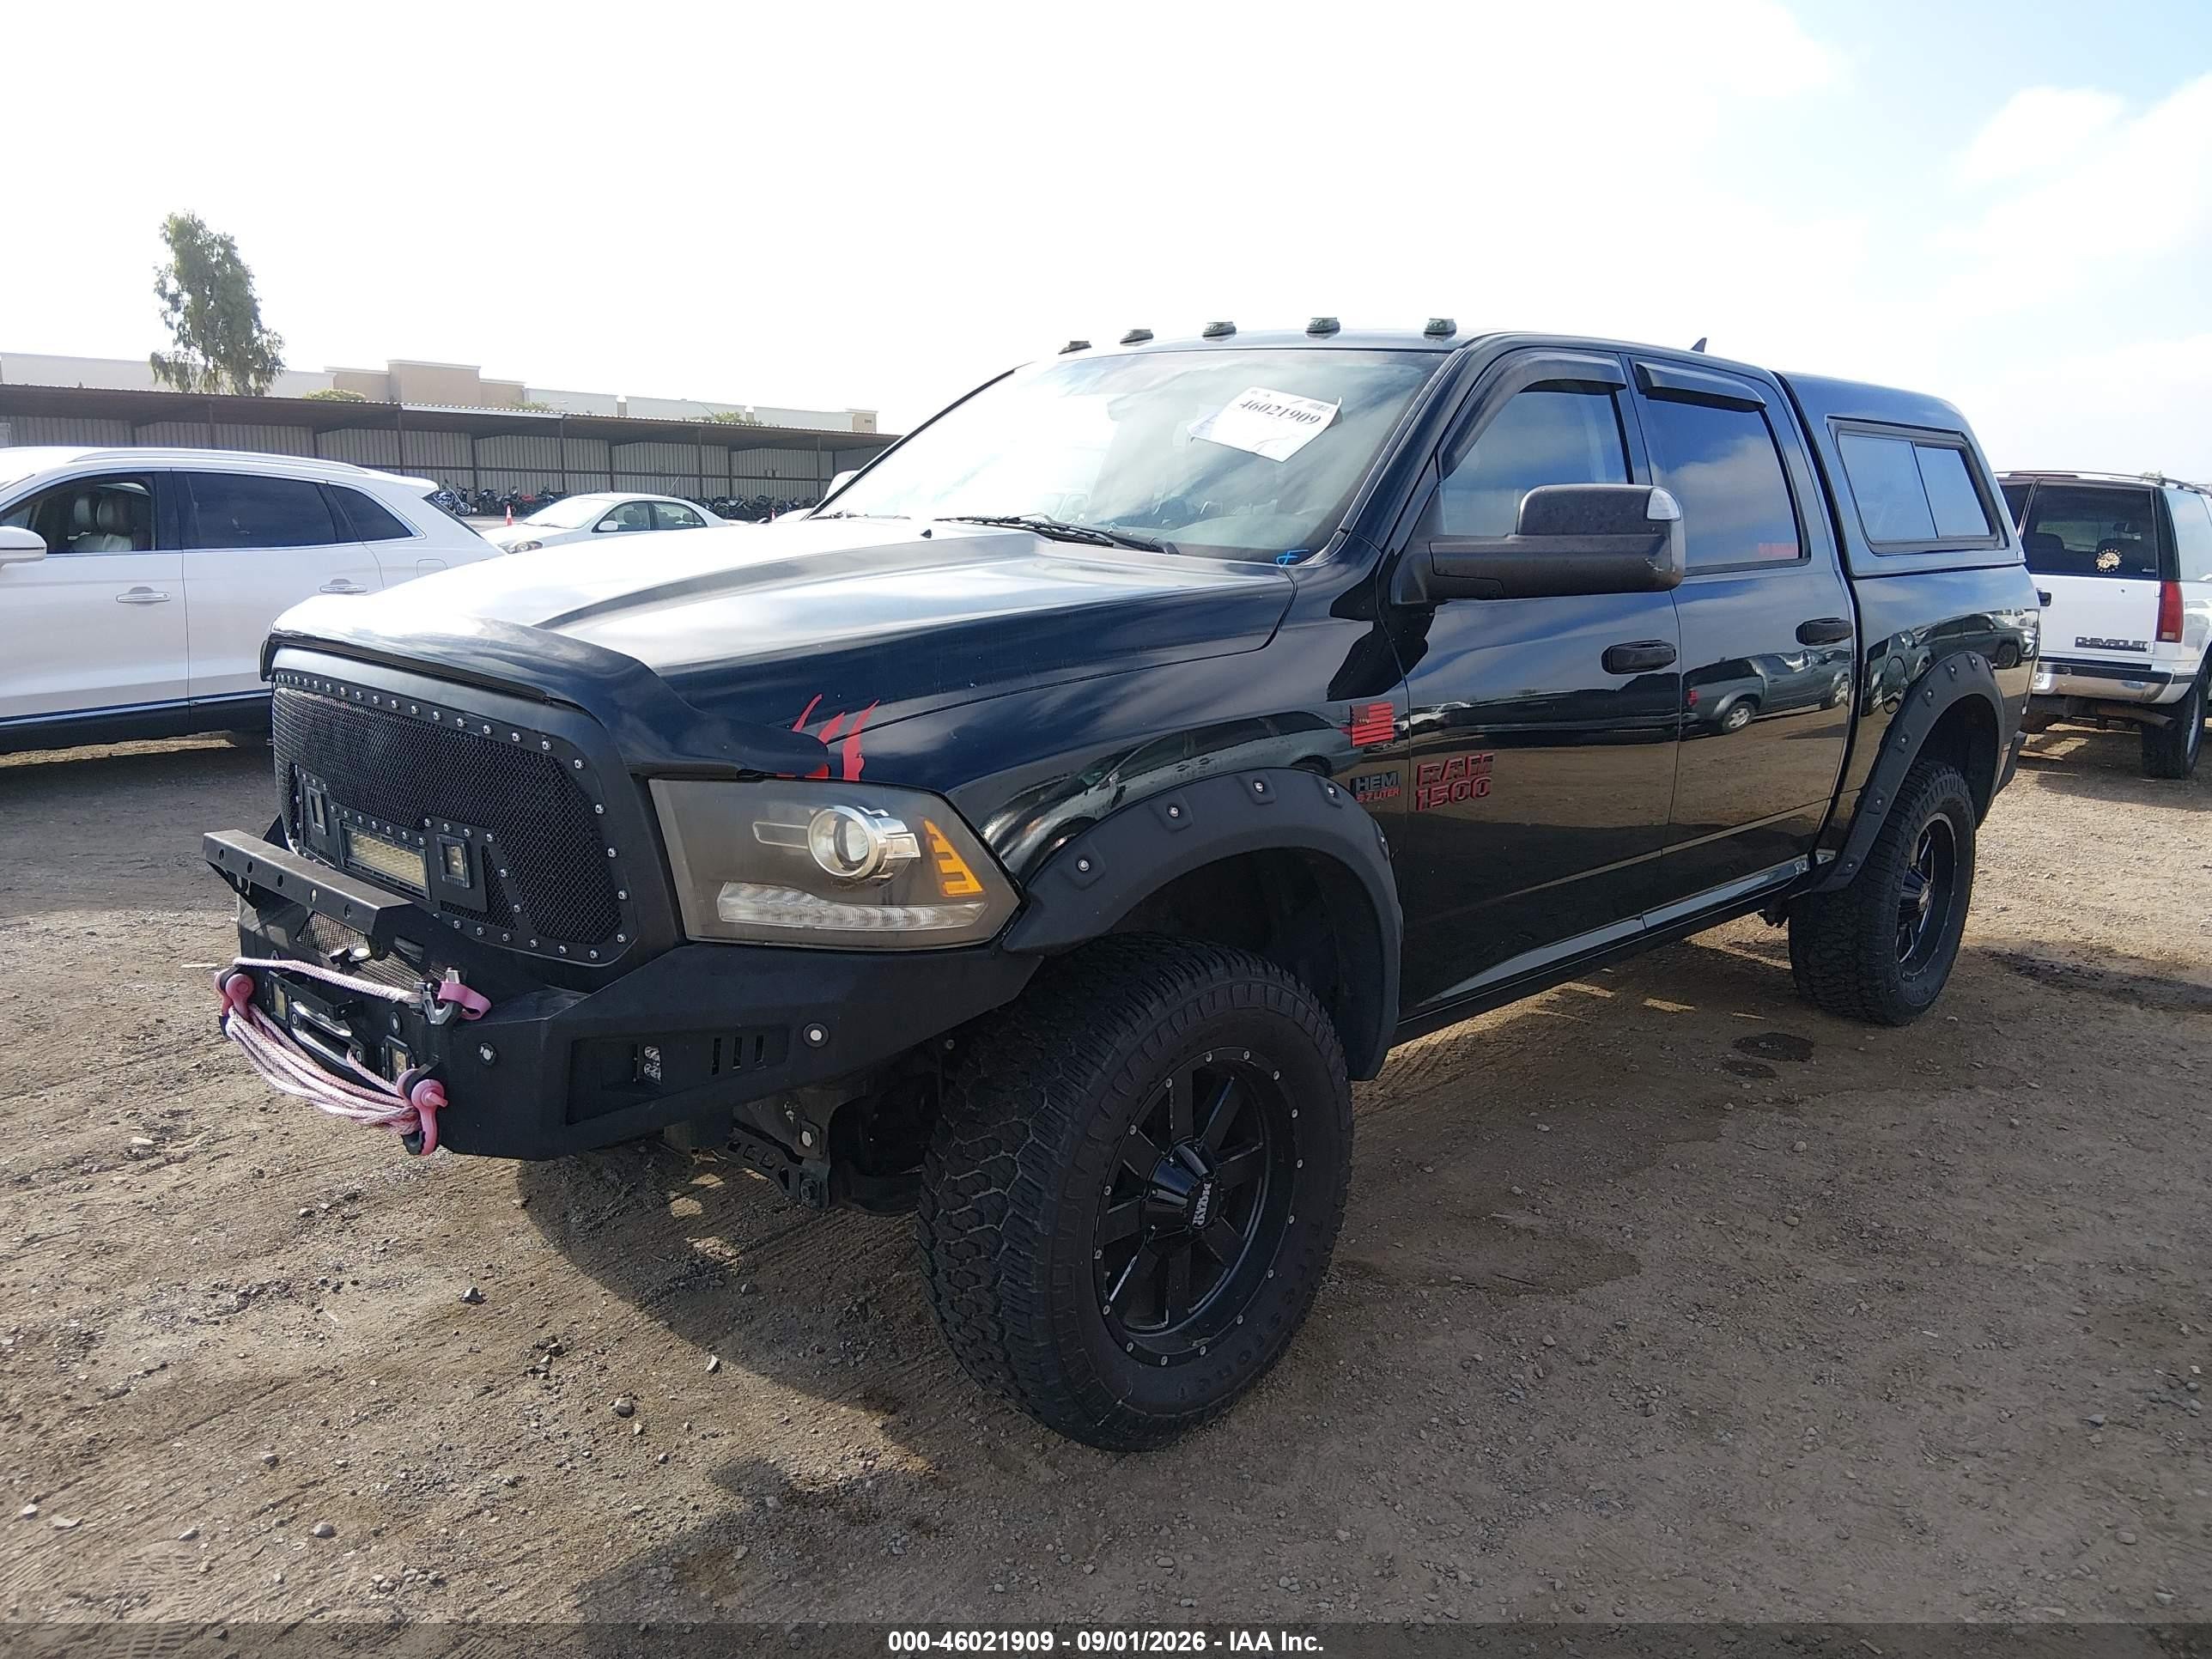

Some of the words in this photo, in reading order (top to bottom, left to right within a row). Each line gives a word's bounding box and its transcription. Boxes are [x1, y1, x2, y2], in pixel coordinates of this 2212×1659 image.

[1239, 399, 1321, 424] 46021909
[1354, 773, 1401, 793] HEMI
[1417, 752, 1495, 787] RAM
[1416, 777, 1492, 811] 1500
